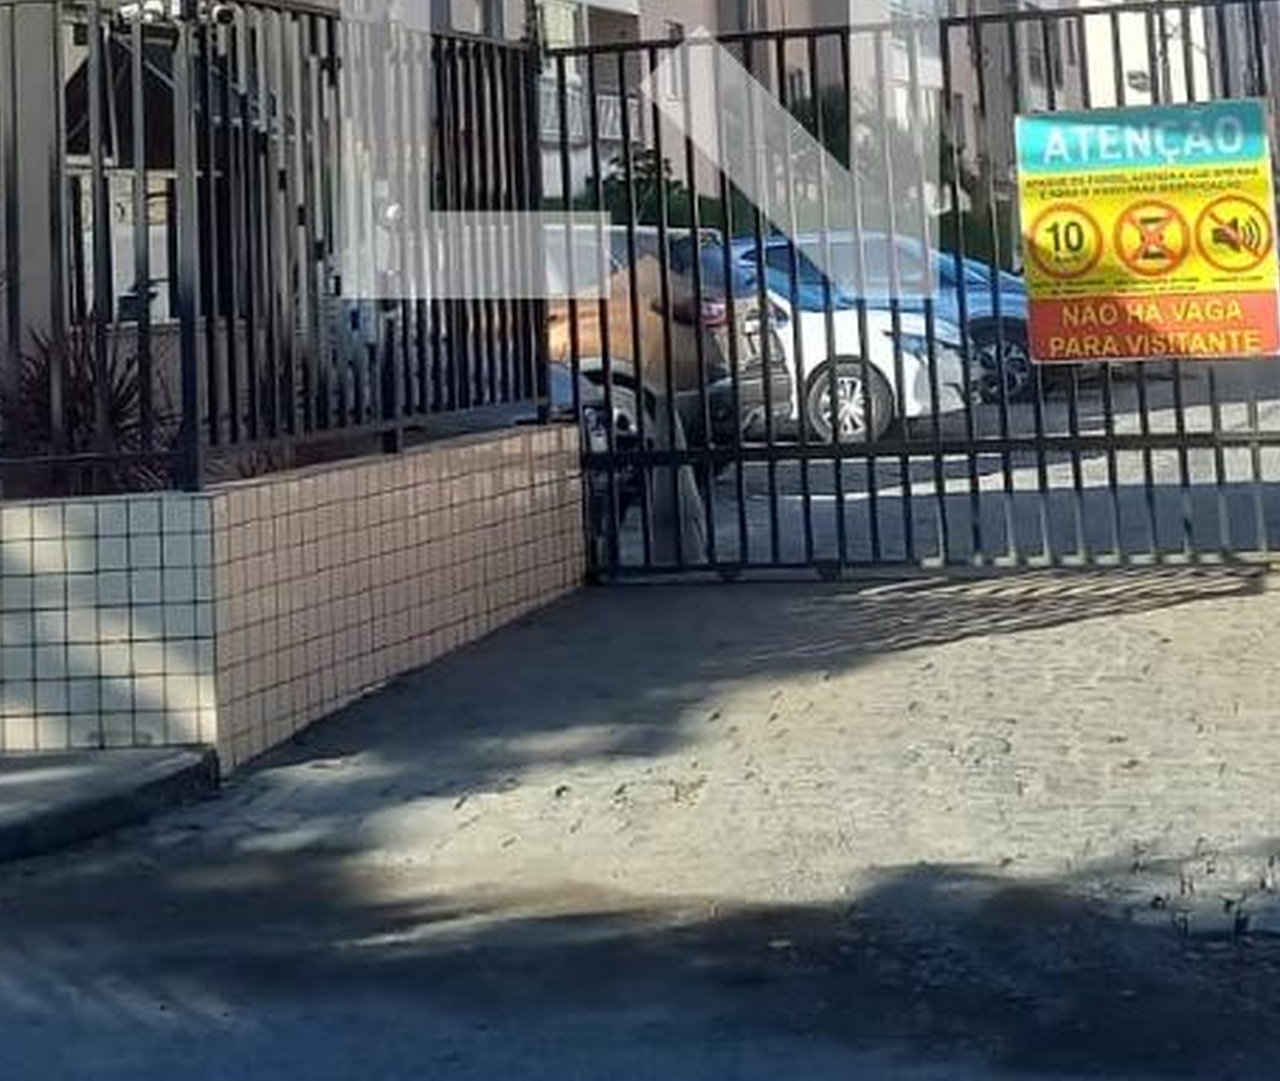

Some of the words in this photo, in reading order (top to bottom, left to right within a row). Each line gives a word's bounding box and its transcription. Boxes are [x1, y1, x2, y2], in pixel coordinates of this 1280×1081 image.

[1045, 221, 1084, 252] 10
[1170, 298, 1243, 322] VAGA
[1048, 334, 1121, 358] PARA
[1125, 329, 1262, 355] VISITANTE
